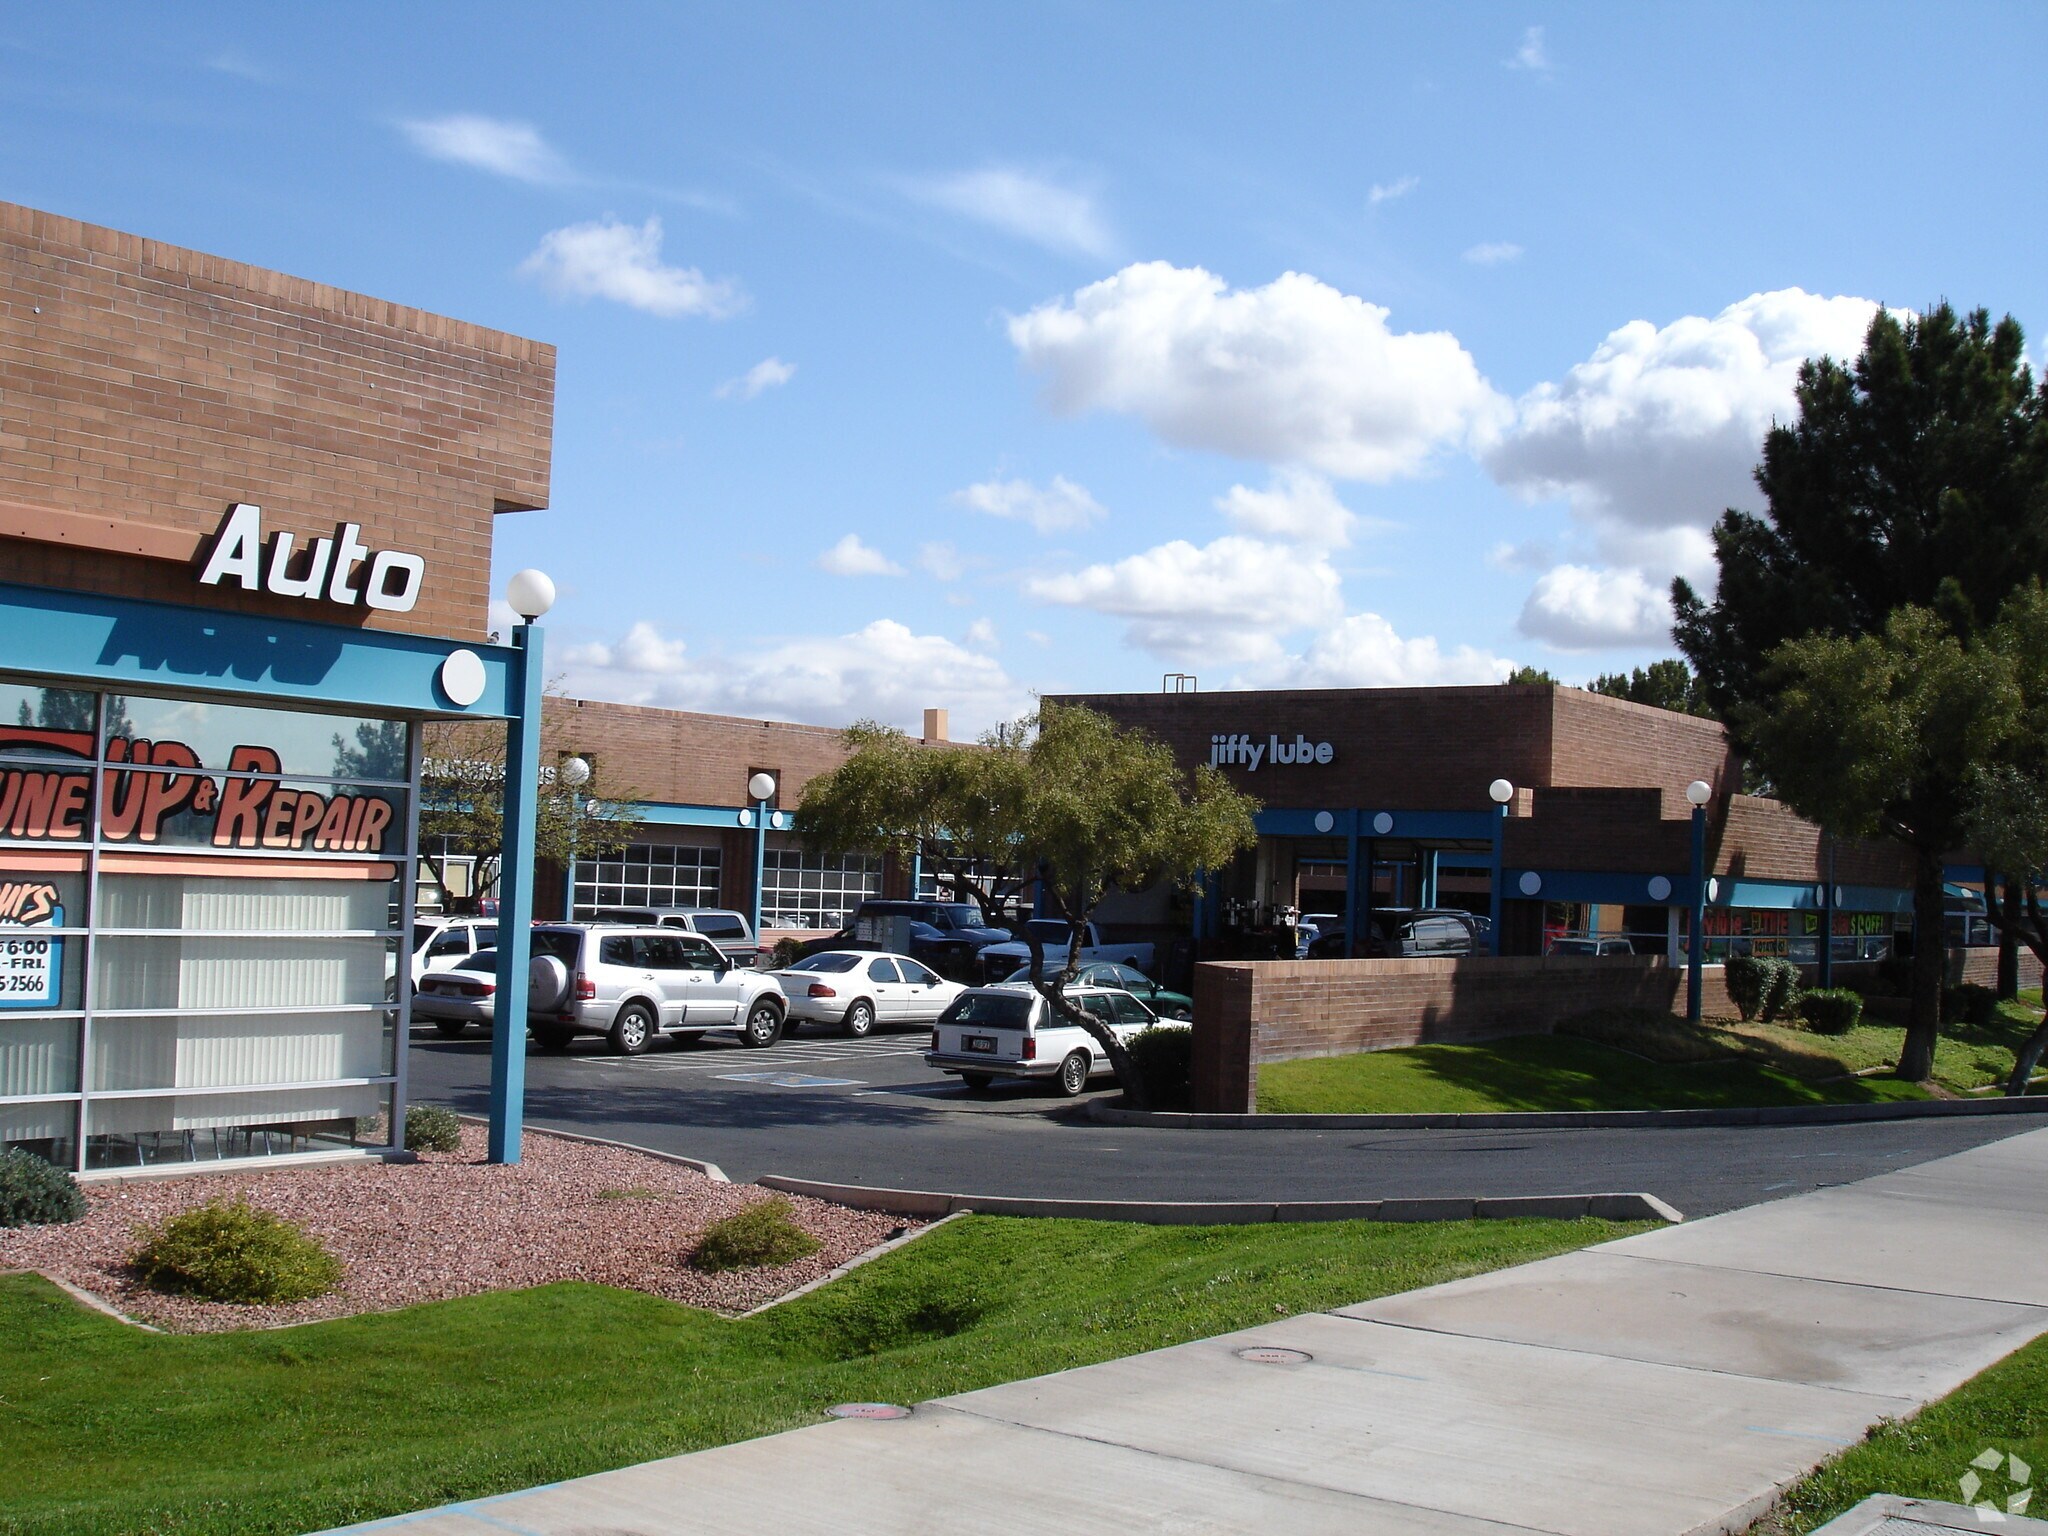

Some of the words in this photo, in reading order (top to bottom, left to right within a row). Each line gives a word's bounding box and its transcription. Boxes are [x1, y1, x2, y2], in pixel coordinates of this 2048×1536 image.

[199, 503, 426, 613] Auto
[1208, 734, 1266, 772] jiffy
[1269, 734, 1334, 765] lube
[0, 730, 92, 842] UNE
[101, 736, 203, 843] UP
[192, 776, 219, 815] &
[212, 745, 392, 851] REPAIR
[0, 881, 59, 925] urs
[7, 939, 49, 956] 6:00
